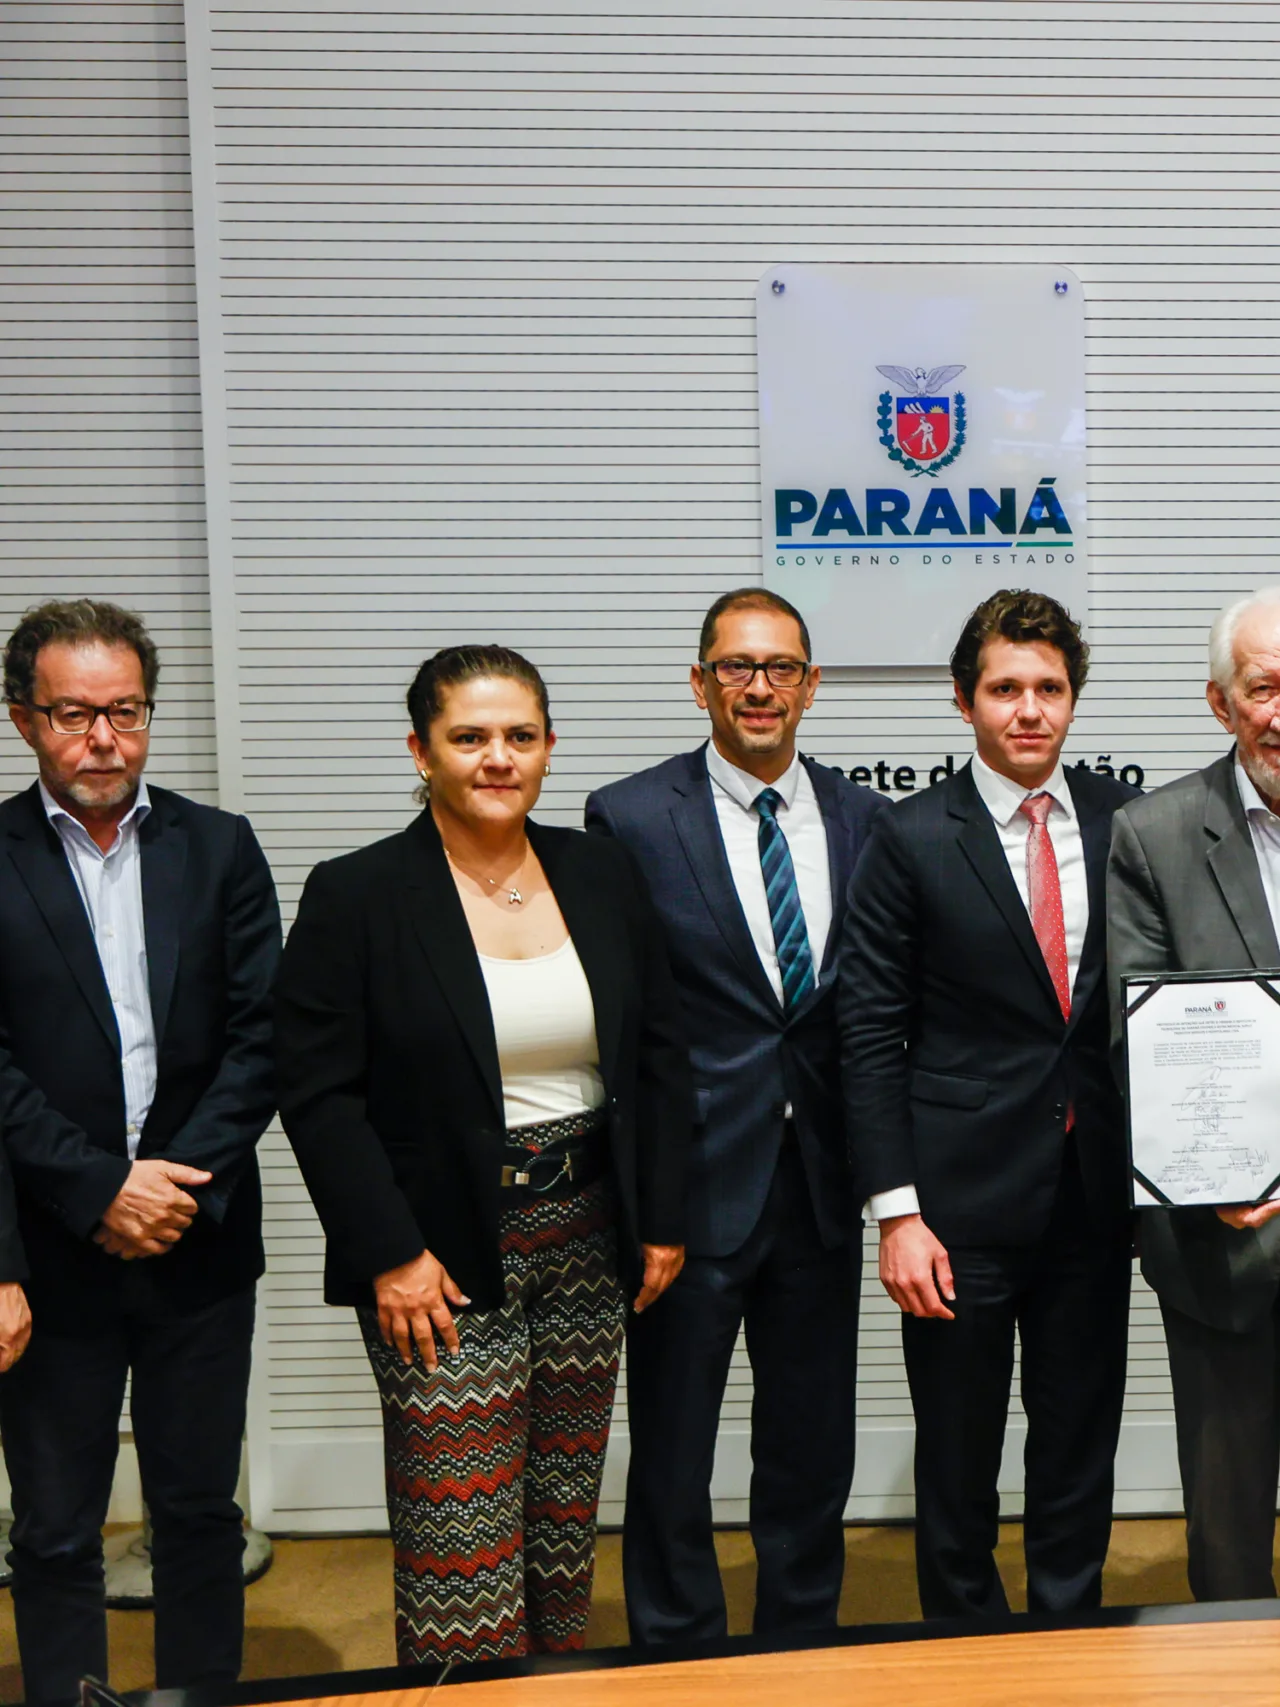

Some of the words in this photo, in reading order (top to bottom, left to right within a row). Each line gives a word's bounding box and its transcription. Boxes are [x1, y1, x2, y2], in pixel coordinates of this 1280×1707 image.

[775, 477, 1073, 537] PARANÁ
[776, 555, 900, 567] GOVERNO
[923, 554, 952, 565] DO
[975, 554, 1075, 565] ESTADO
[1185, 1005, 1212, 1013] PARANÁ
